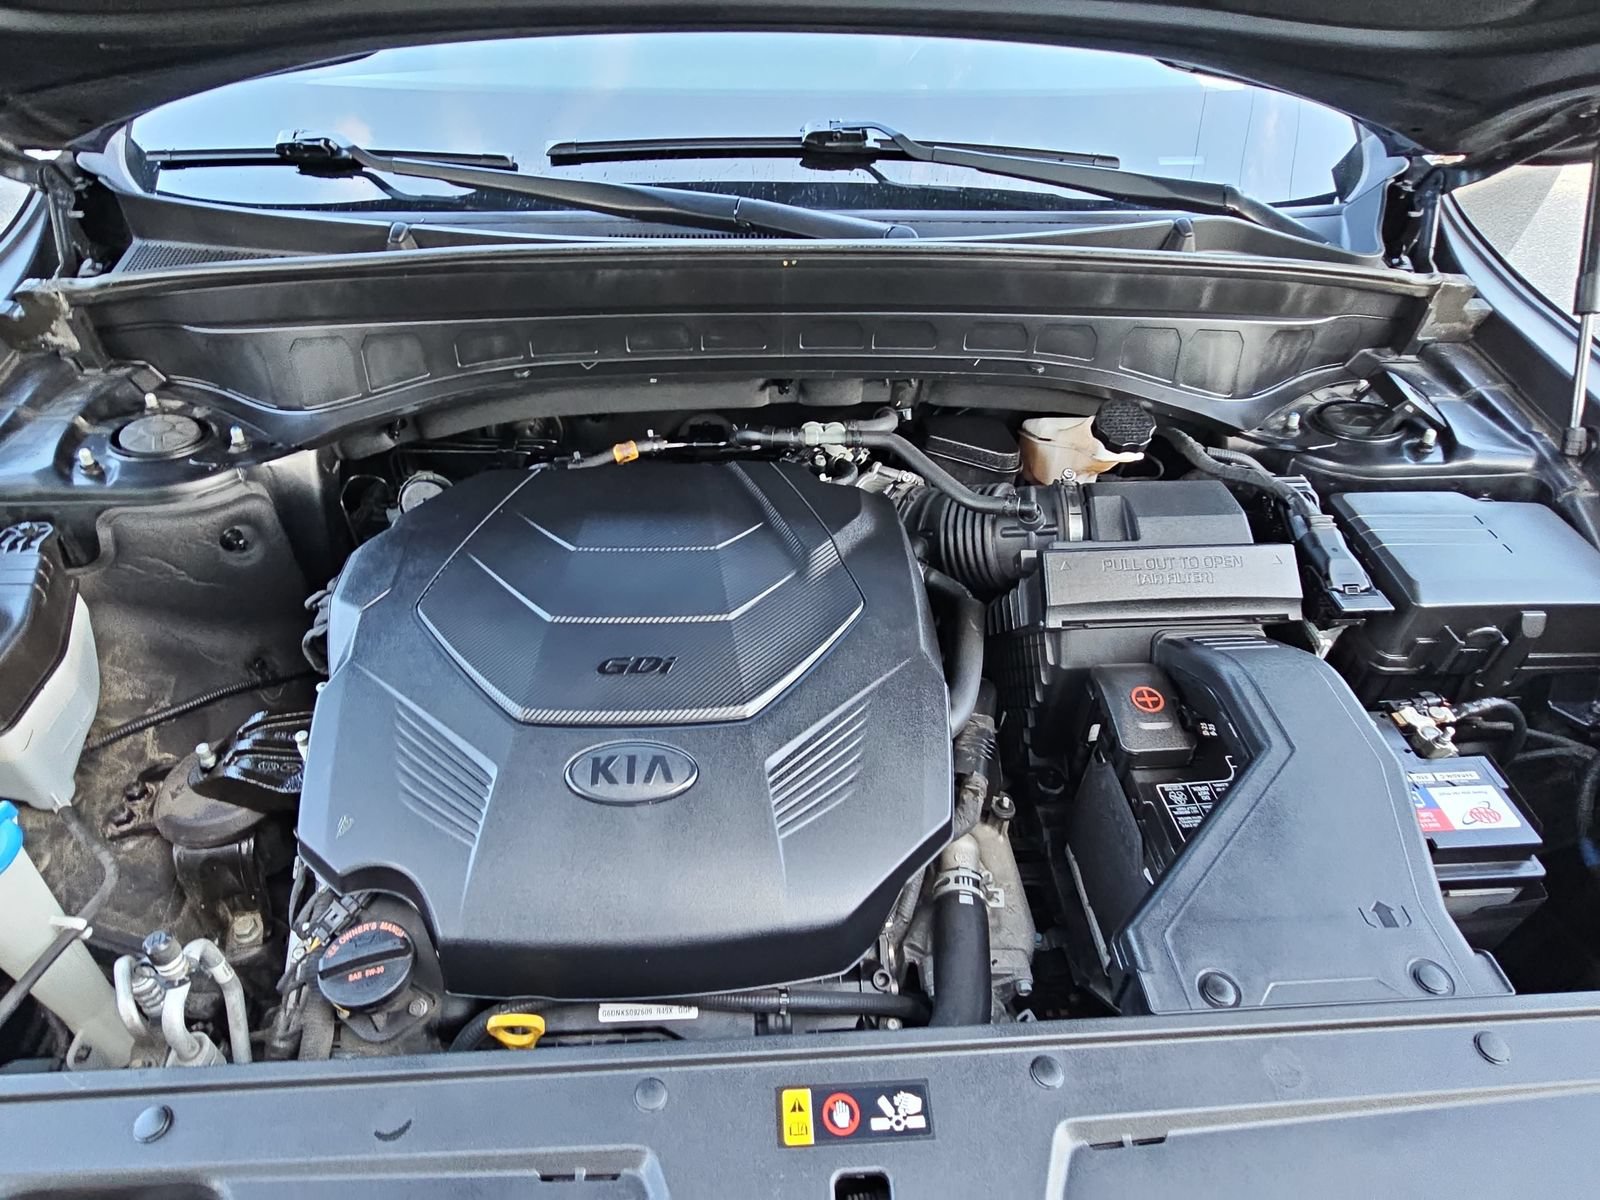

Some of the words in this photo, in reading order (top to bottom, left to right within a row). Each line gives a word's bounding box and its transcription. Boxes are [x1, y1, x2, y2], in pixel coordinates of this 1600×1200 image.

[1102, 558, 1142, 572] PULL
[1146, 557, 1175, 571] OUT
[1179, 556, 1200, 570] TO
[1204, 555, 1243, 569] OPEN
[590, 754, 674, 787] KIA
[338, 922, 377, 944] OWNER'S
